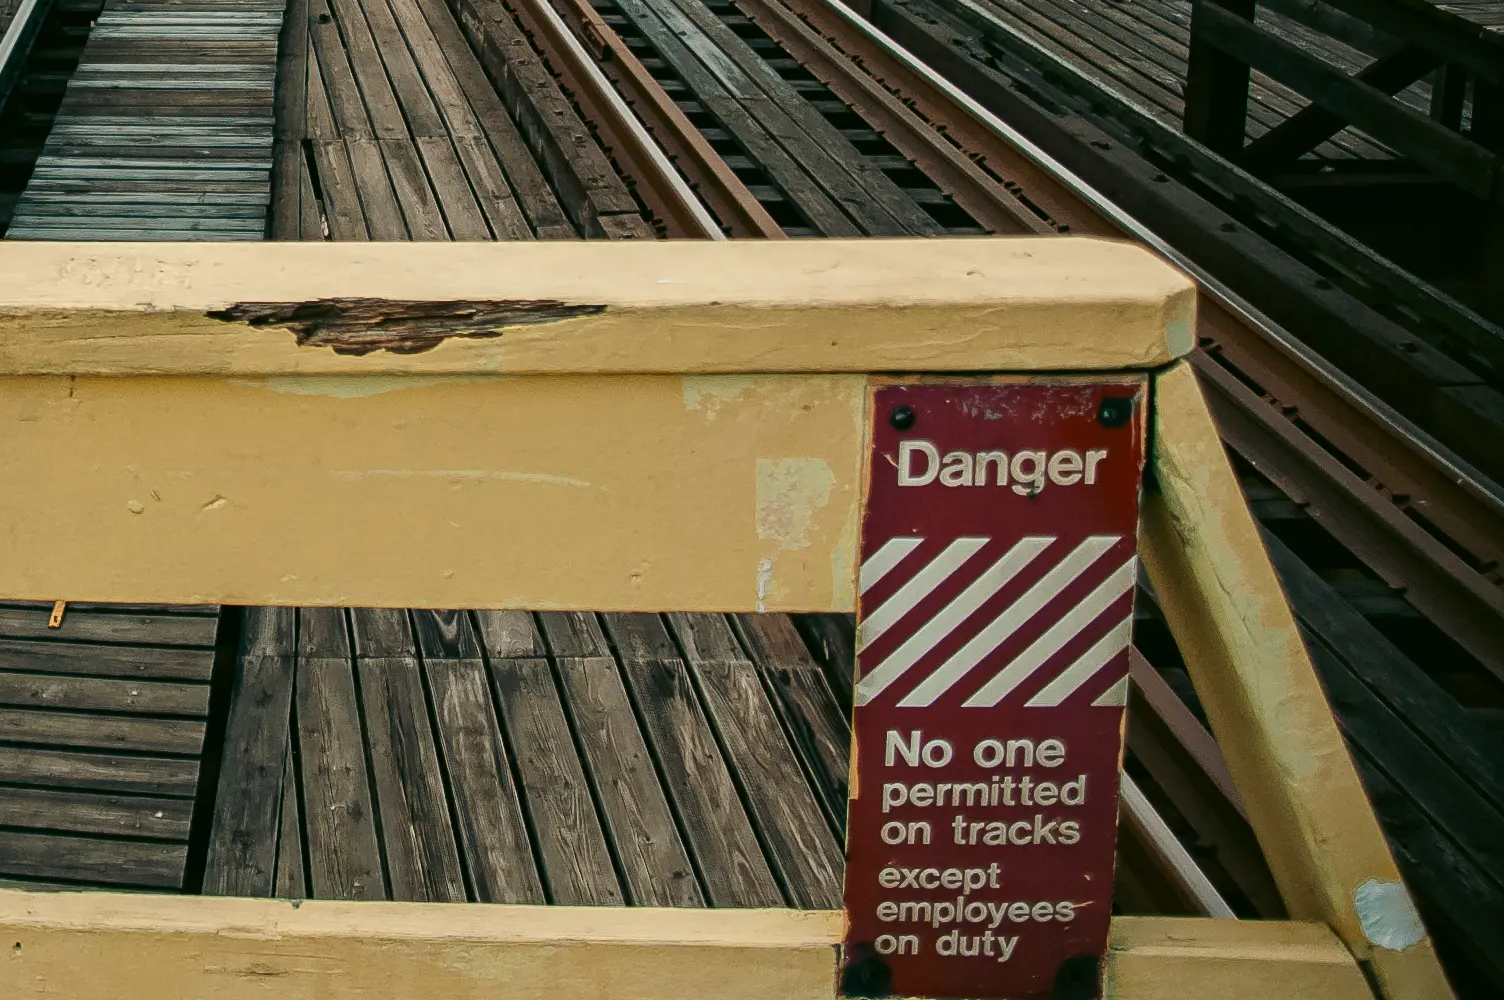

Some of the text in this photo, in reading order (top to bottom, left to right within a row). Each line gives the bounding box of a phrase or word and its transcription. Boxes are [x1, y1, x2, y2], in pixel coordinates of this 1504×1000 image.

[897, 439, 1108, 496] Danger
[884, 729, 1066, 768] No one
[881, 774, 1087, 813] permitted
[880, 814, 1081, 846] on tracks
[878, 862, 1001, 895] except
[876, 896, 1076, 929] employees
[874, 929, 1020, 963] on duty
